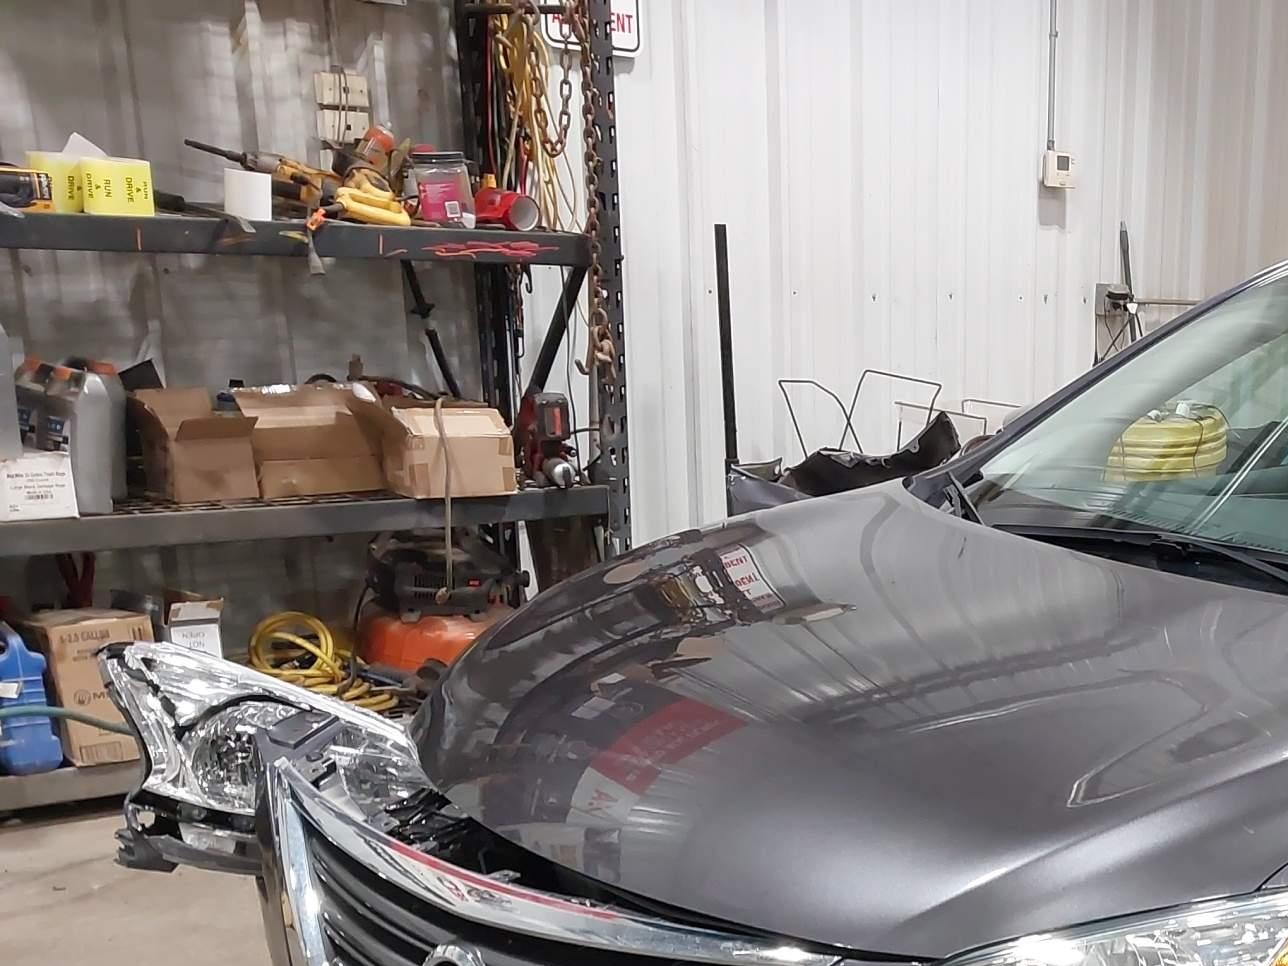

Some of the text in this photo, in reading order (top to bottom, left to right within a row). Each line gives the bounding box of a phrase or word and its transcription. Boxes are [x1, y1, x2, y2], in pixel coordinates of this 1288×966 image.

[67, 175, 75, 200] DRIVE
[103, 179, 113, 198] RUN
[125, 177, 134, 203] DRIVE
